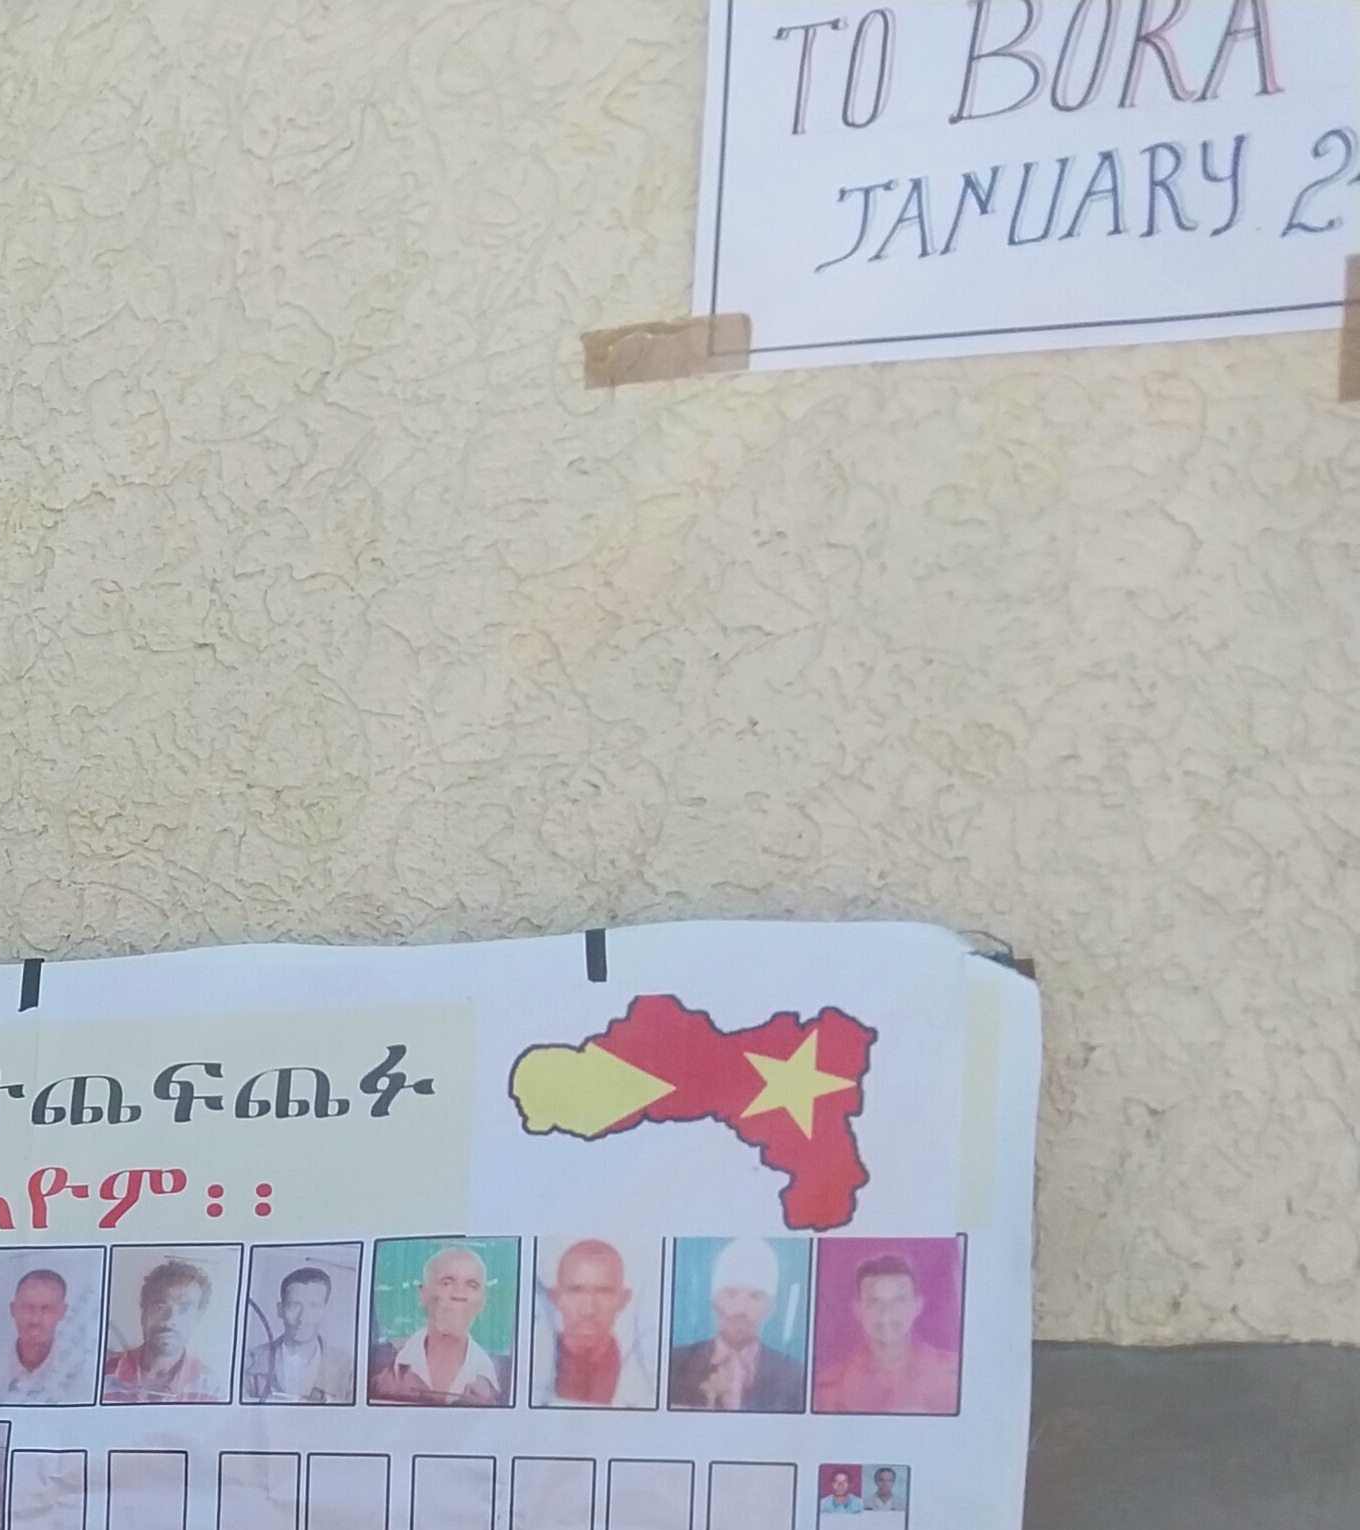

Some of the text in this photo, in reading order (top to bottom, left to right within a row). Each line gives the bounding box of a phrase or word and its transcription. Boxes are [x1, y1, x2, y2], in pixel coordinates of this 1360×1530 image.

[772, 0, 1284, 136] TO BORA
[814, 127, 1360, 273] JANUARY 2
